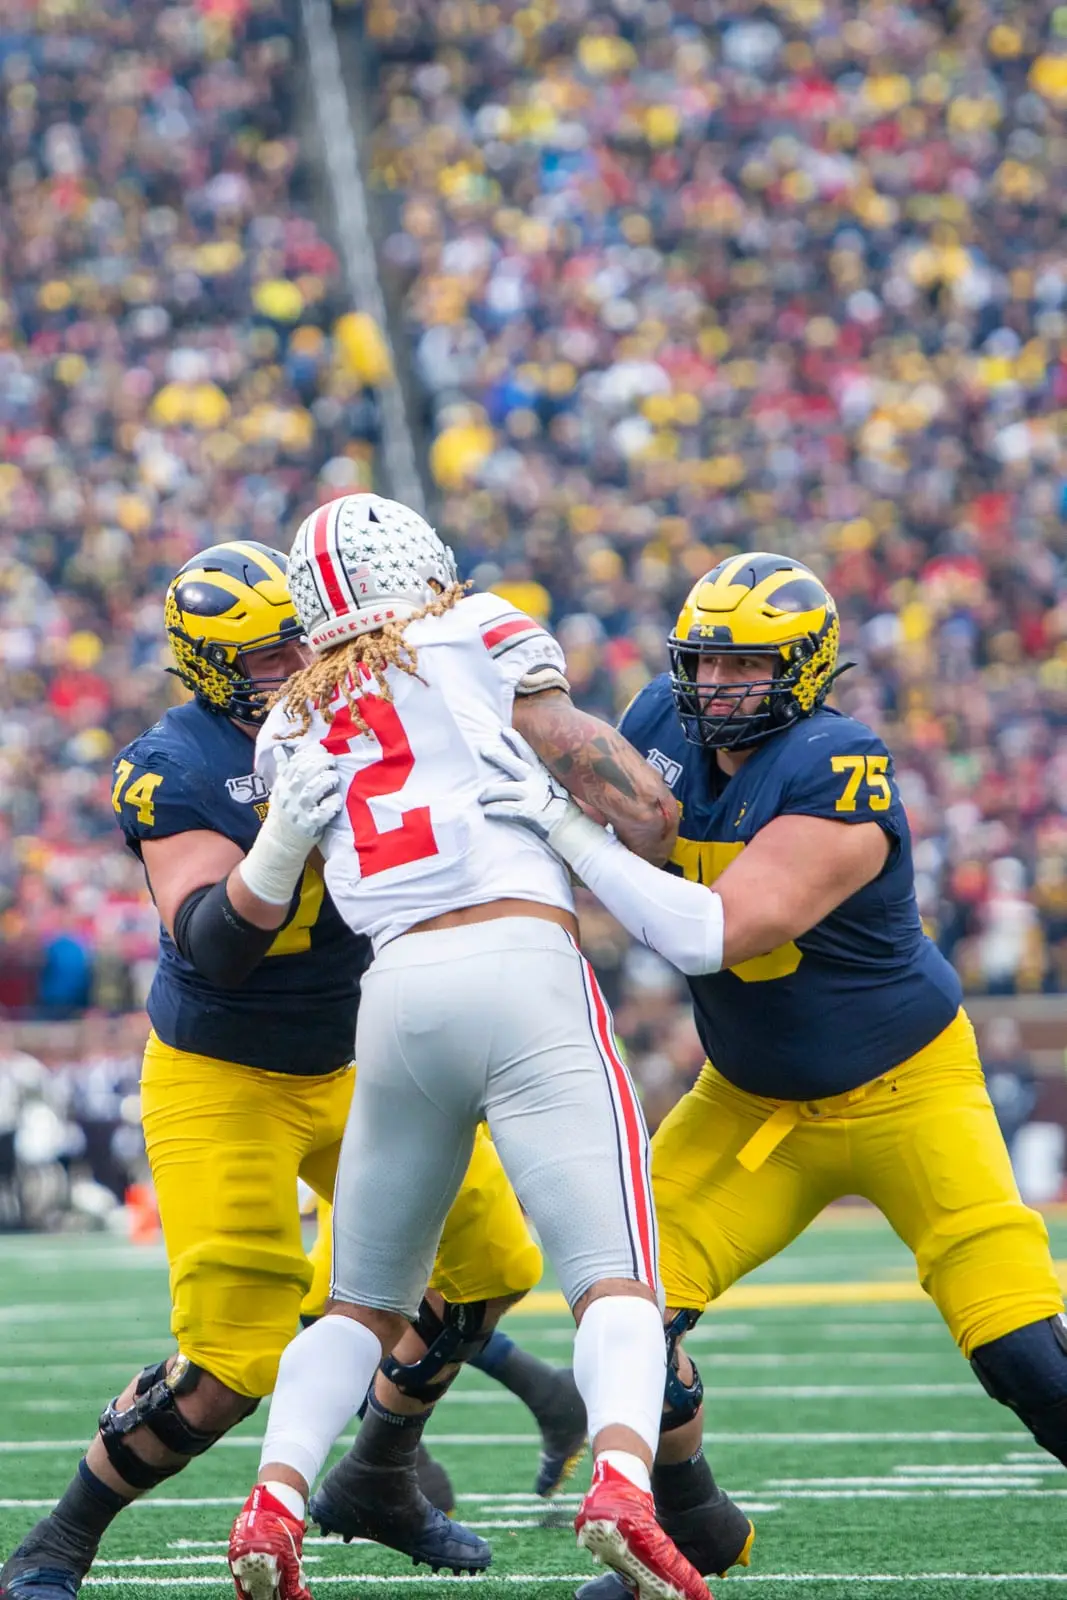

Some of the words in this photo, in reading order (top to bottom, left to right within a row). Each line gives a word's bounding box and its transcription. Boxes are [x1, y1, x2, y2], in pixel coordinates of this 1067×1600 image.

[359, 582, 369, 594] 2
[312, 610, 395, 645] BUCKEYES
[699, 625, 714, 638] M
[111, 758, 164, 826] 74
[320, 692, 439, 878] 2
[830, 755, 892, 812] 75
